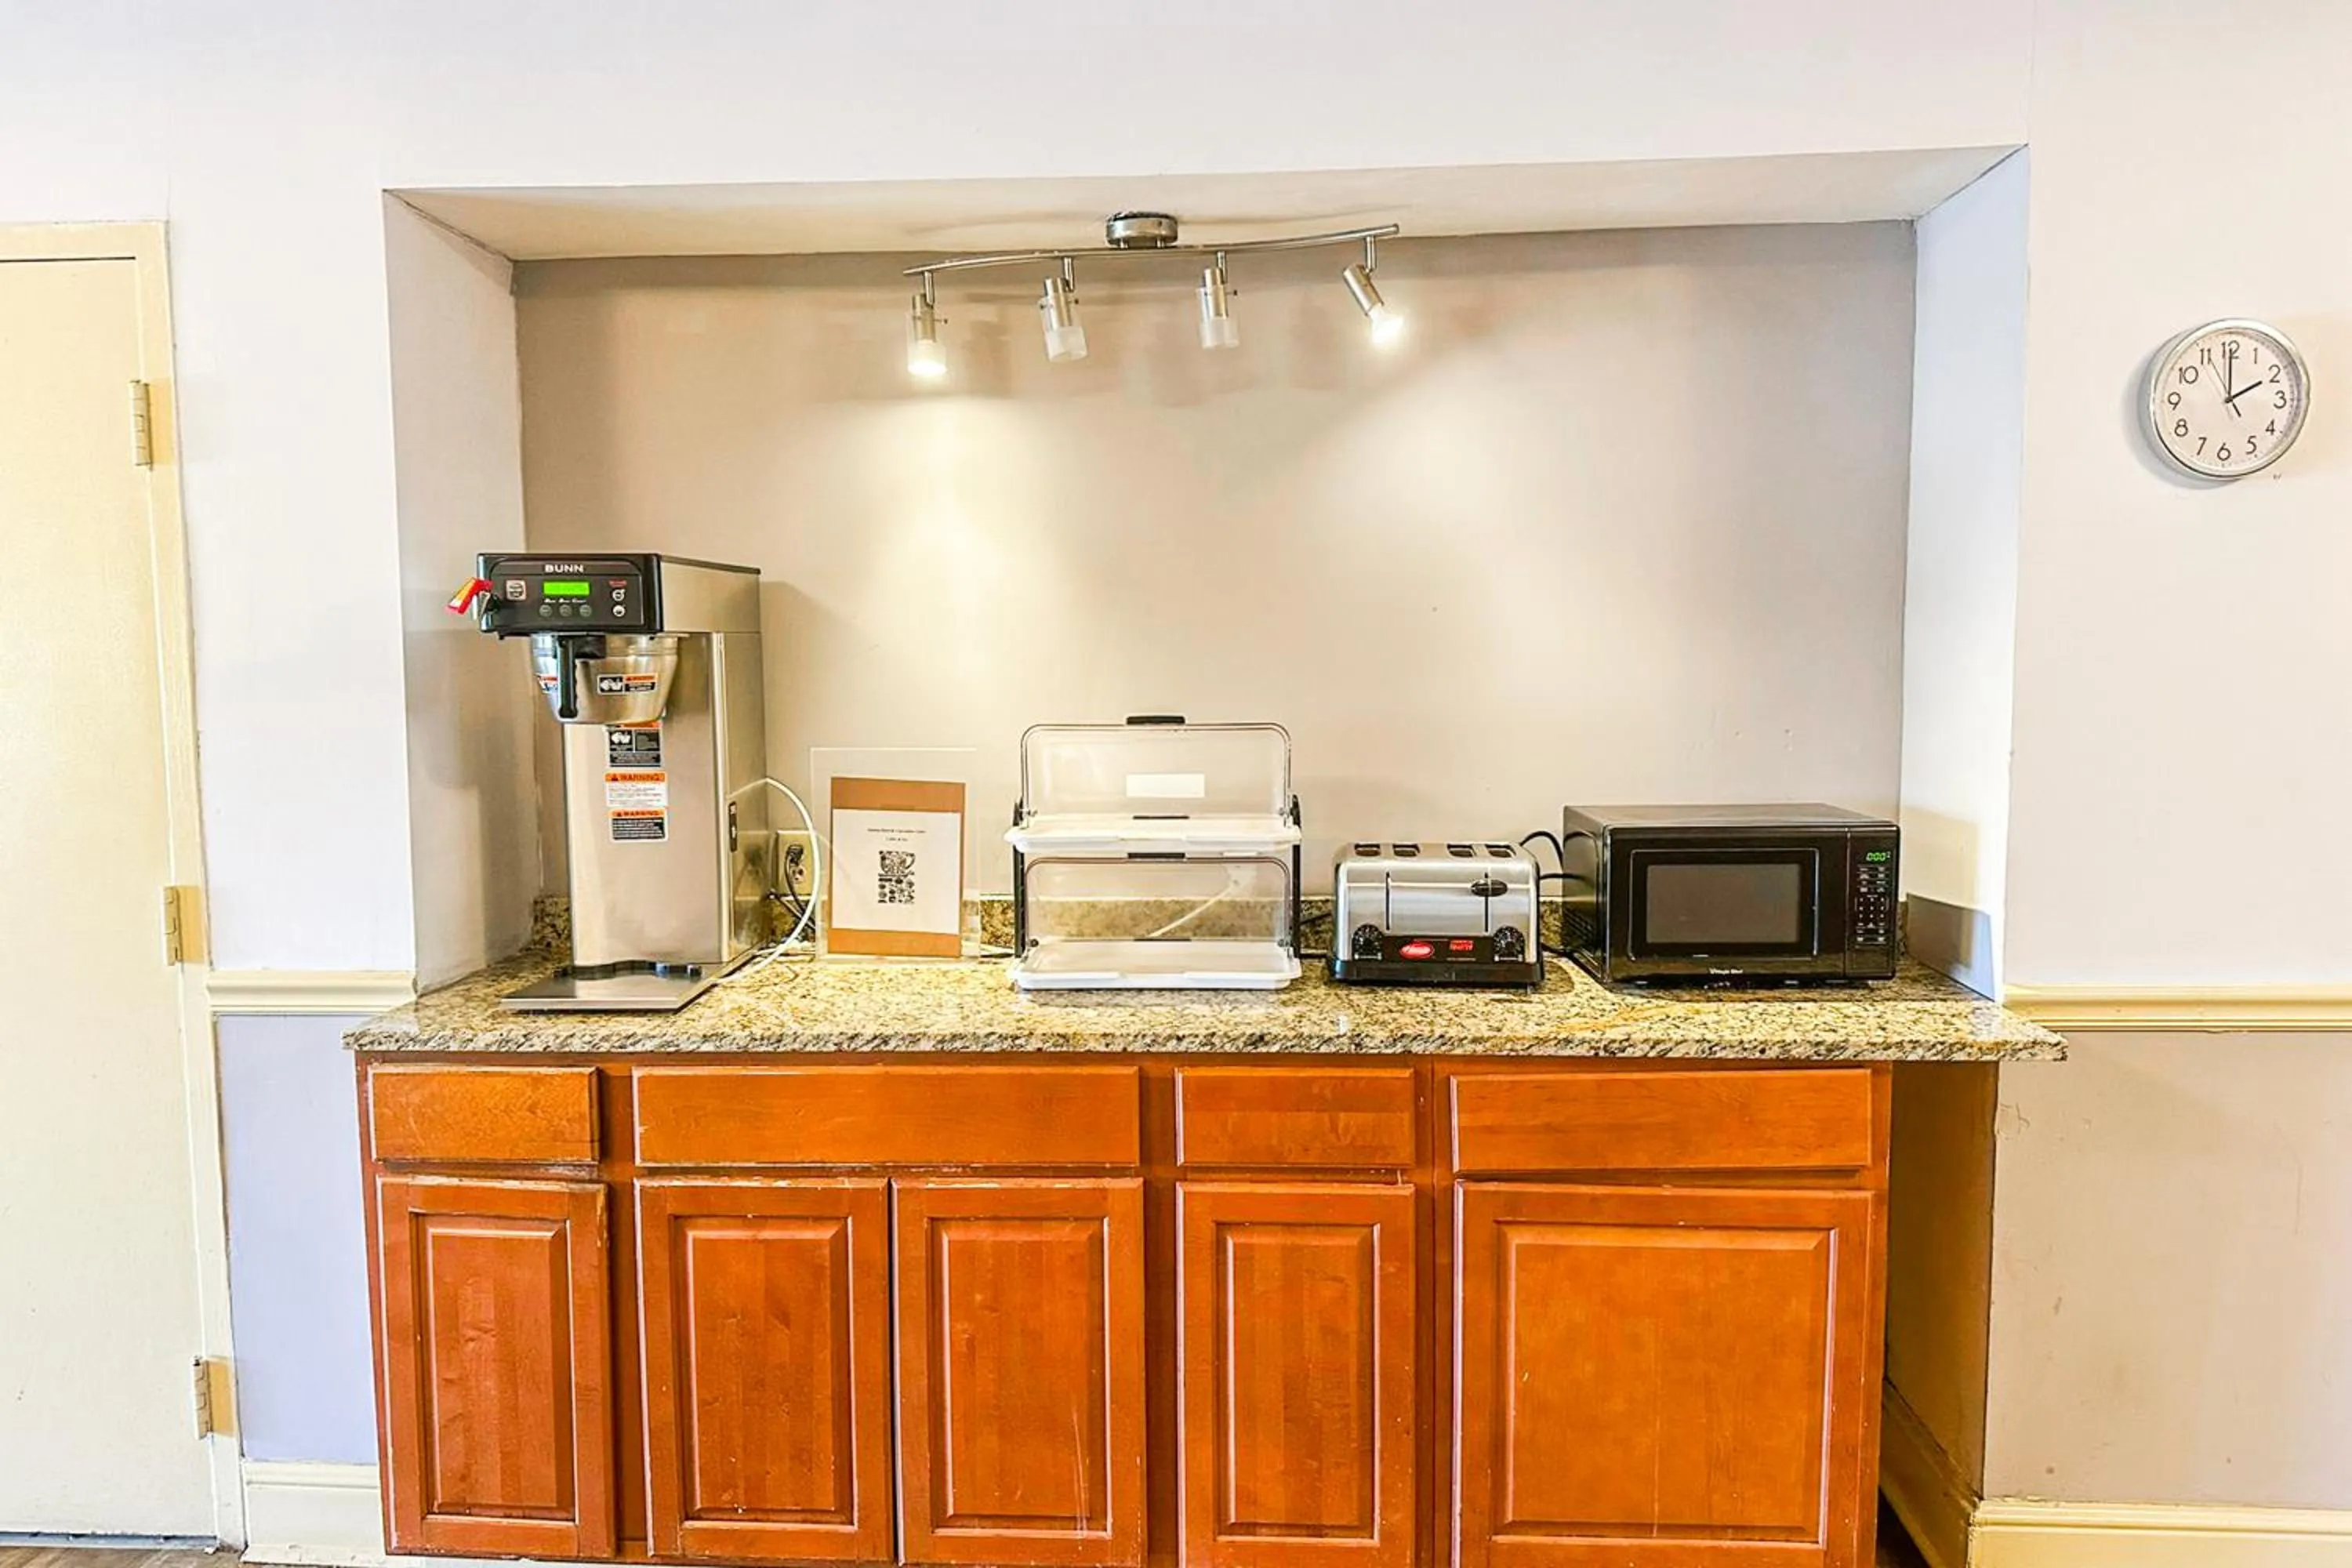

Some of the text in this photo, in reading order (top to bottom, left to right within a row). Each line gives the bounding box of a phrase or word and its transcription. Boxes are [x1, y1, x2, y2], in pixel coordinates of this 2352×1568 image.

[2200, 348, 2212, 365] 11
[2221, 340, 2240, 359] 12
[2252, 347, 2259, 364] 1
[2178, 365, 2199, 384] 10
[2268, 364, 2281, 383] 2
[2168, 391, 2181, 411] 9
[2274, 390, 2287, 409] 3
[2174, 418, 2188, 437] 8
[2265, 419, 2276, 436] 4
[2196, 437, 2208, 456] 7
[2216, 442, 2231, 461] 6
[2245, 435, 2257, 455] 5
[544, 564, 585, 573] BUNN
